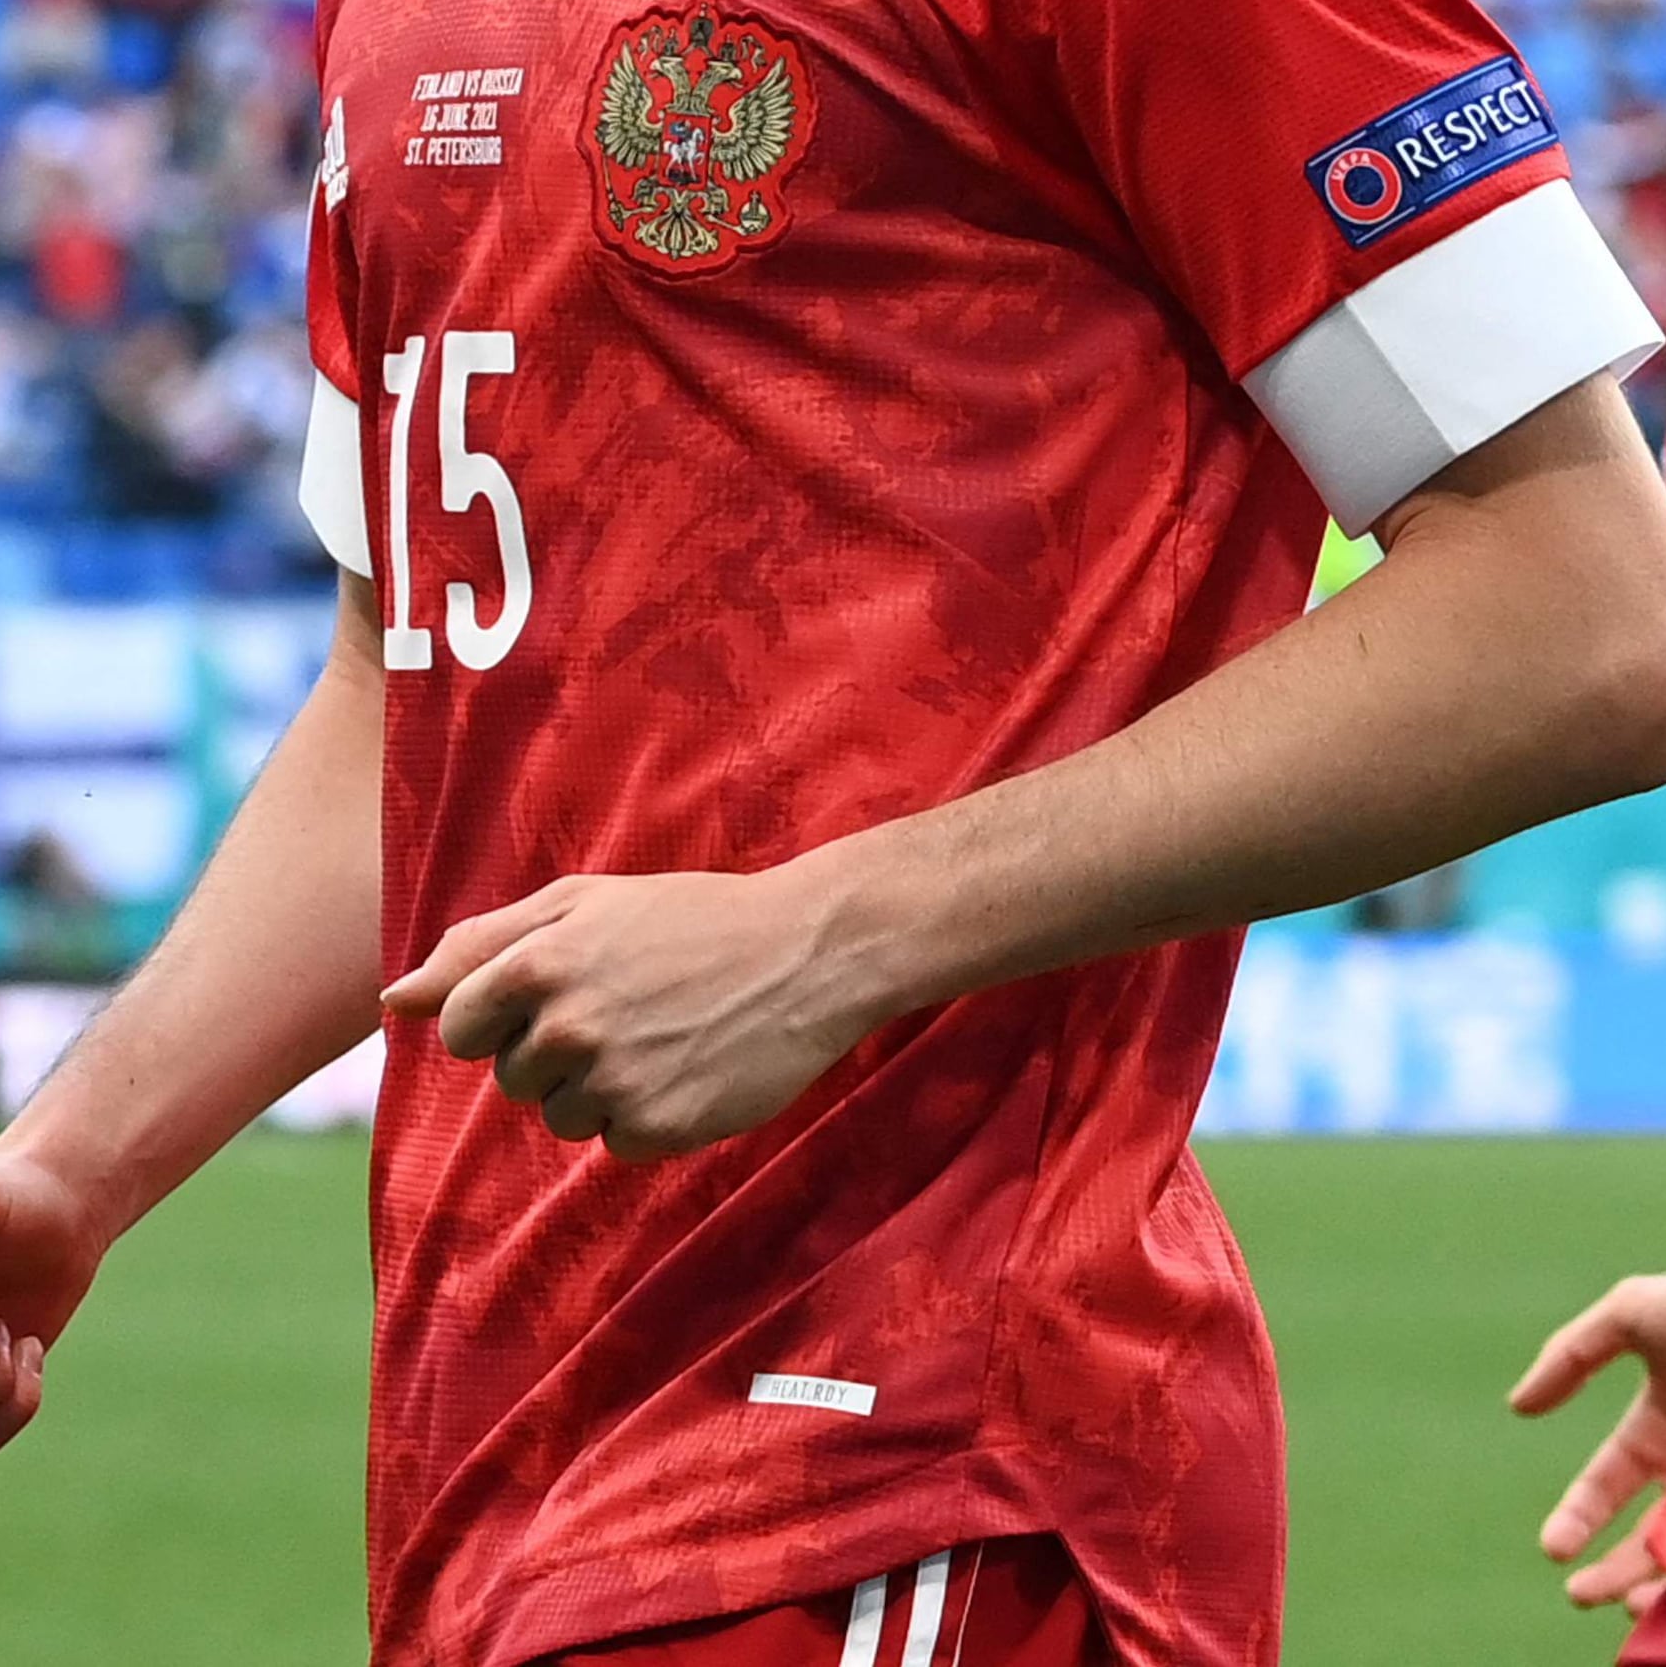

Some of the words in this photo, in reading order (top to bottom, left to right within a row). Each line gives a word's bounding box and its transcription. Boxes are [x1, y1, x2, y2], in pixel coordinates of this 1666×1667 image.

[411, 70, 466, 101] FINLAND
[464, 68, 483, 97] VS
[479, 67, 524, 96] RUSSIA
[437, 102, 471, 131] JUNE
[470, 101, 498, 130] 2021
[1395, 80, 1541, 178] RESPECT
[404, 137, 425, 166] ST.
[426, 136, 502, 165] PETERSBURG
[1330, 152, 1371, 181] UEFA
[383, 329, 532, 671] 15
